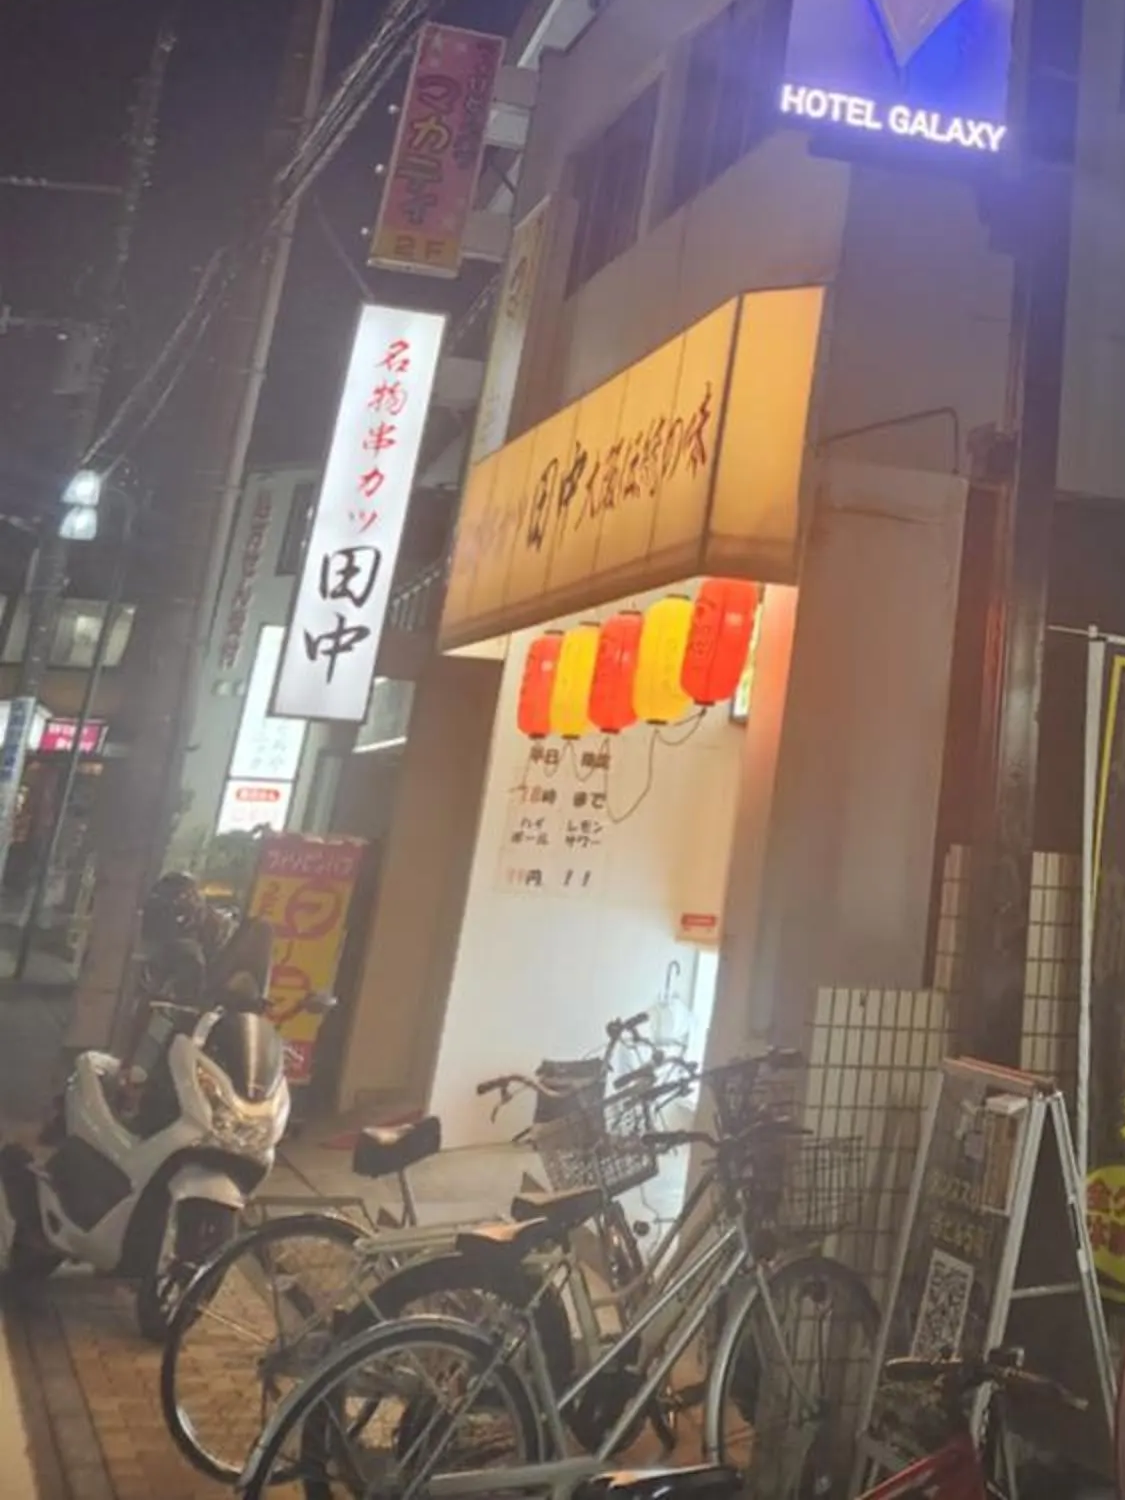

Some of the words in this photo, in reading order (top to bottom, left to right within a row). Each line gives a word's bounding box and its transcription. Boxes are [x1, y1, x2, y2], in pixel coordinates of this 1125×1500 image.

[781, 84, 883, 131] HOTEL
[888, 104, 1007, 153] GALAXY
[302, 543, 384, 689] 田中
